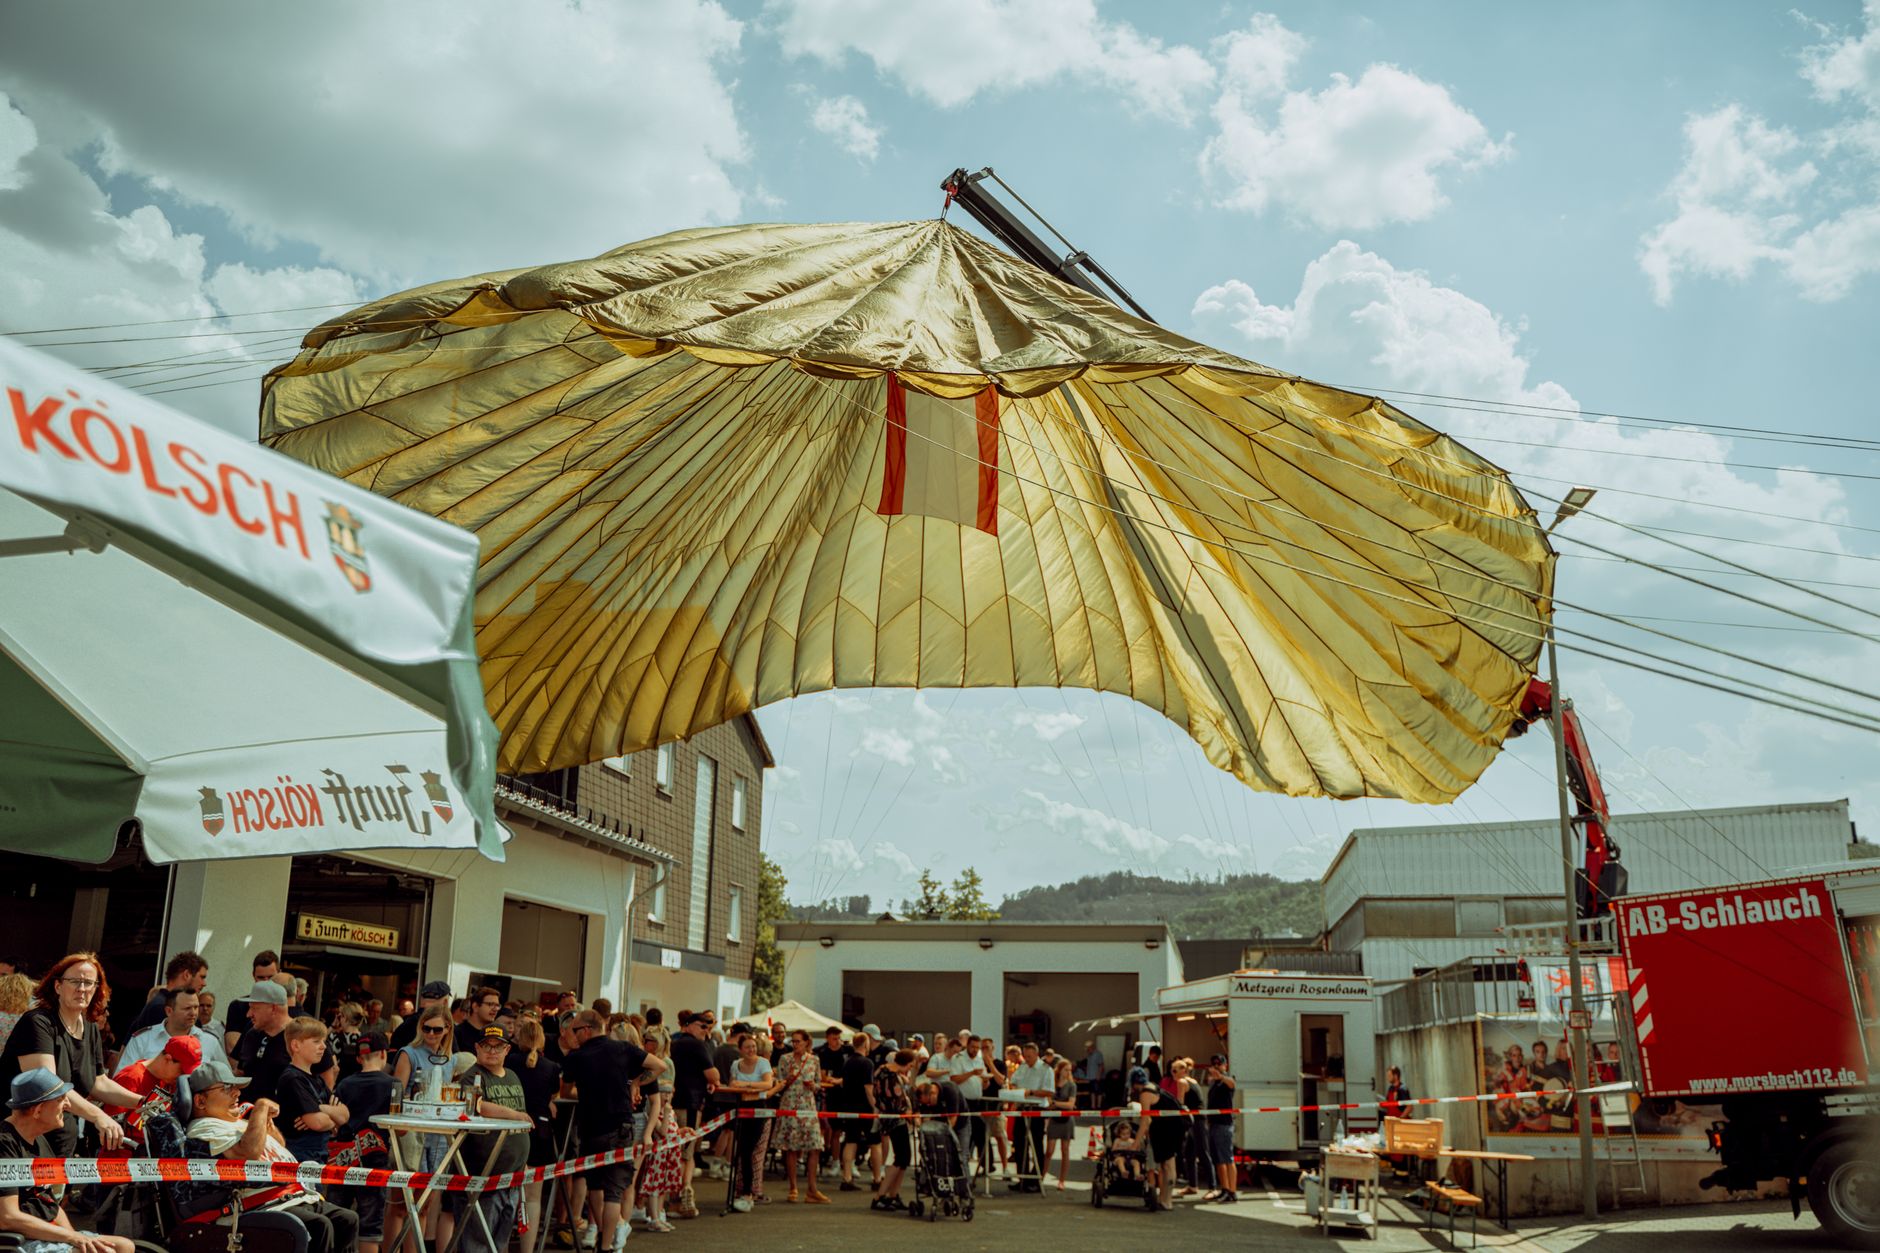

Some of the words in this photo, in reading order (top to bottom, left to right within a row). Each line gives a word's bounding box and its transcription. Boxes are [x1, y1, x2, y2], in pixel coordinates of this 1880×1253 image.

[7, 386, 313, 561] KÖLSCH
[1628, 887, 1822, 937] AB-Schlauch
[315, 920, 350, 940] Zunft
[350, 928, 386, 945] KÖLSCH
[1235, 981, 1296, 996] Metzgerei
[1299, 983, 1369, 996] Rosenbaum
[1688, 1067, 1857, 1090] www.morsbach112.de
